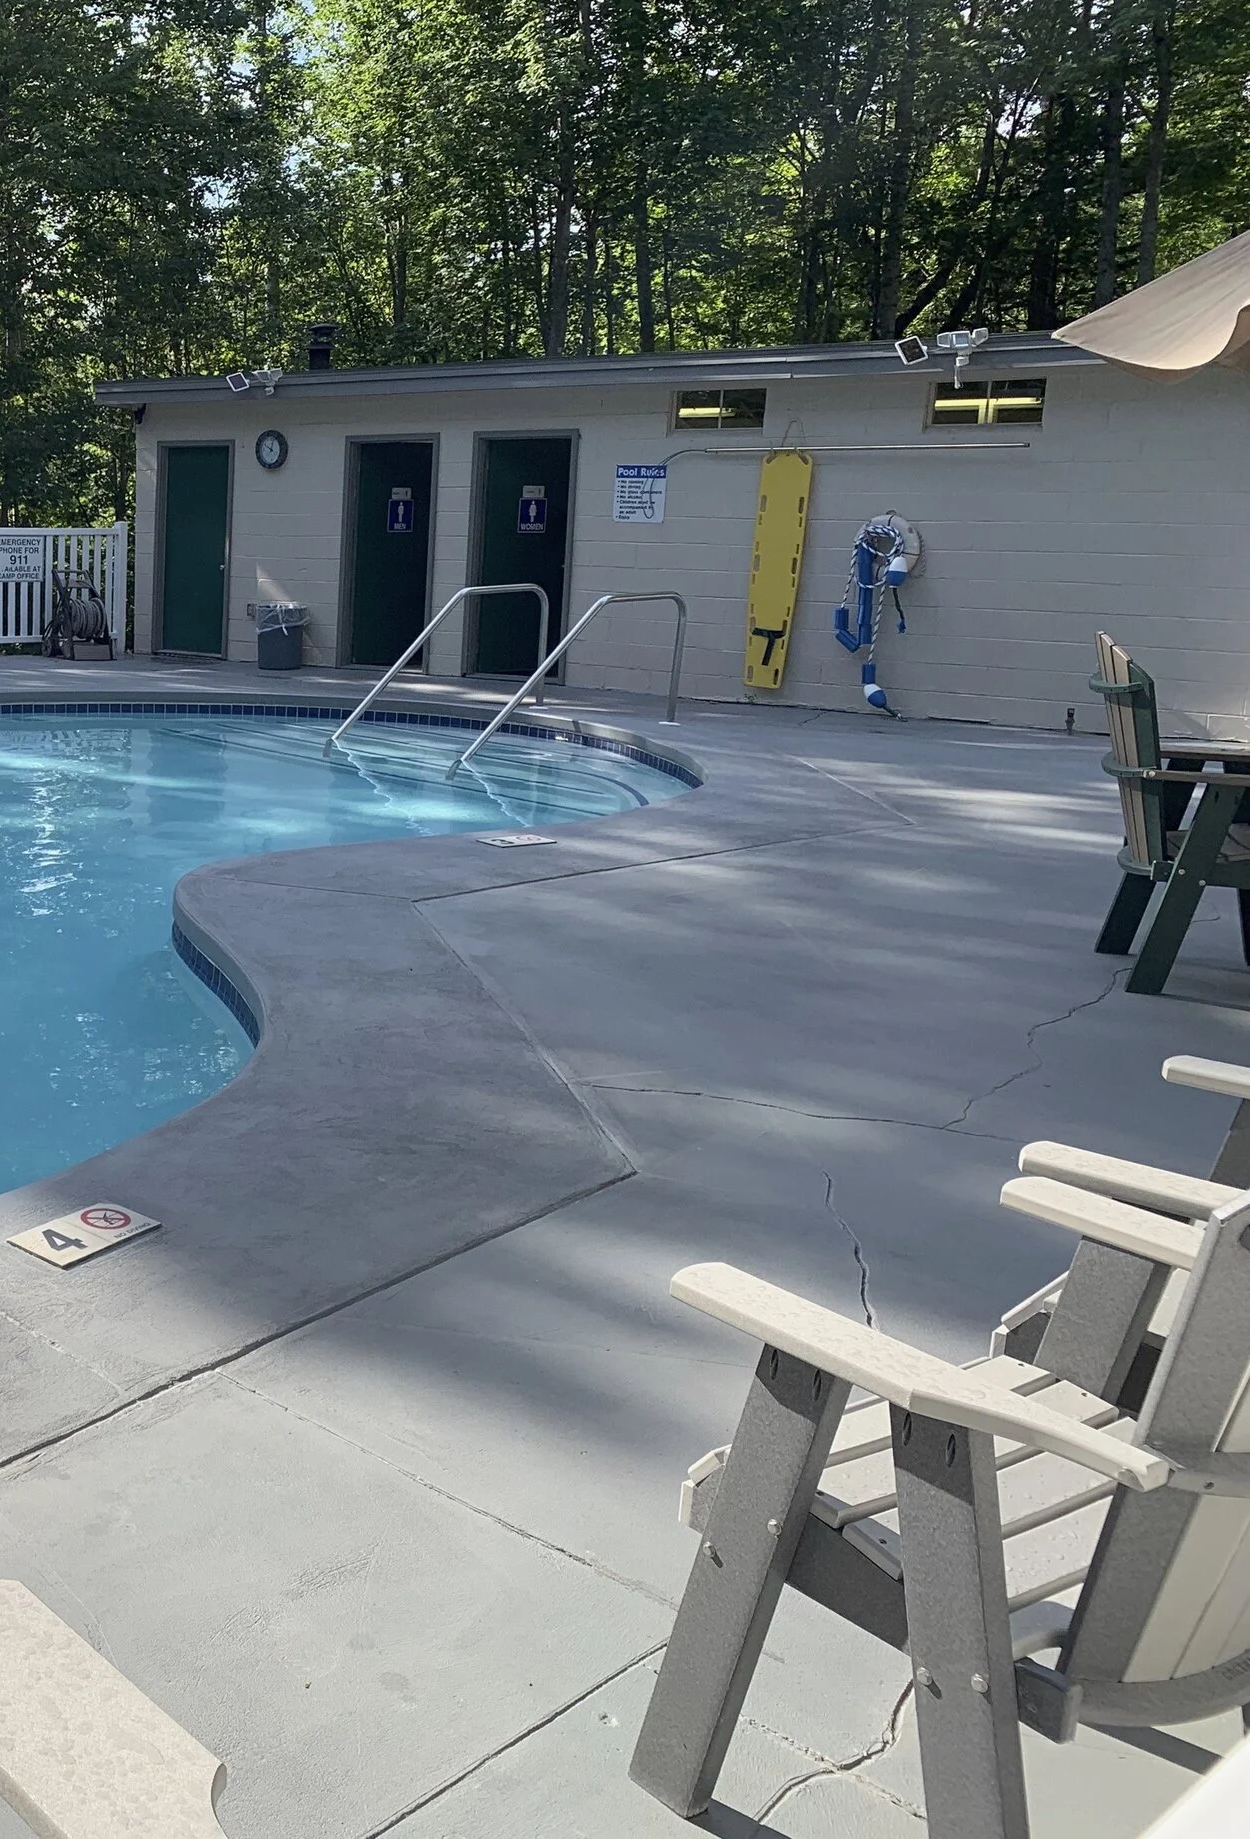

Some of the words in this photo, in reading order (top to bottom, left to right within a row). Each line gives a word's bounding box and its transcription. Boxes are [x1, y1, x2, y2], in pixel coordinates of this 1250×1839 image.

[618, 468, 638, 476] Pool
[520, 522, 544, 530] WOMEN
[10, 554, 28, 565] 911
[126, 1222, 151, 1234] DIVING
[42, 1228, 88, 1252] 4
